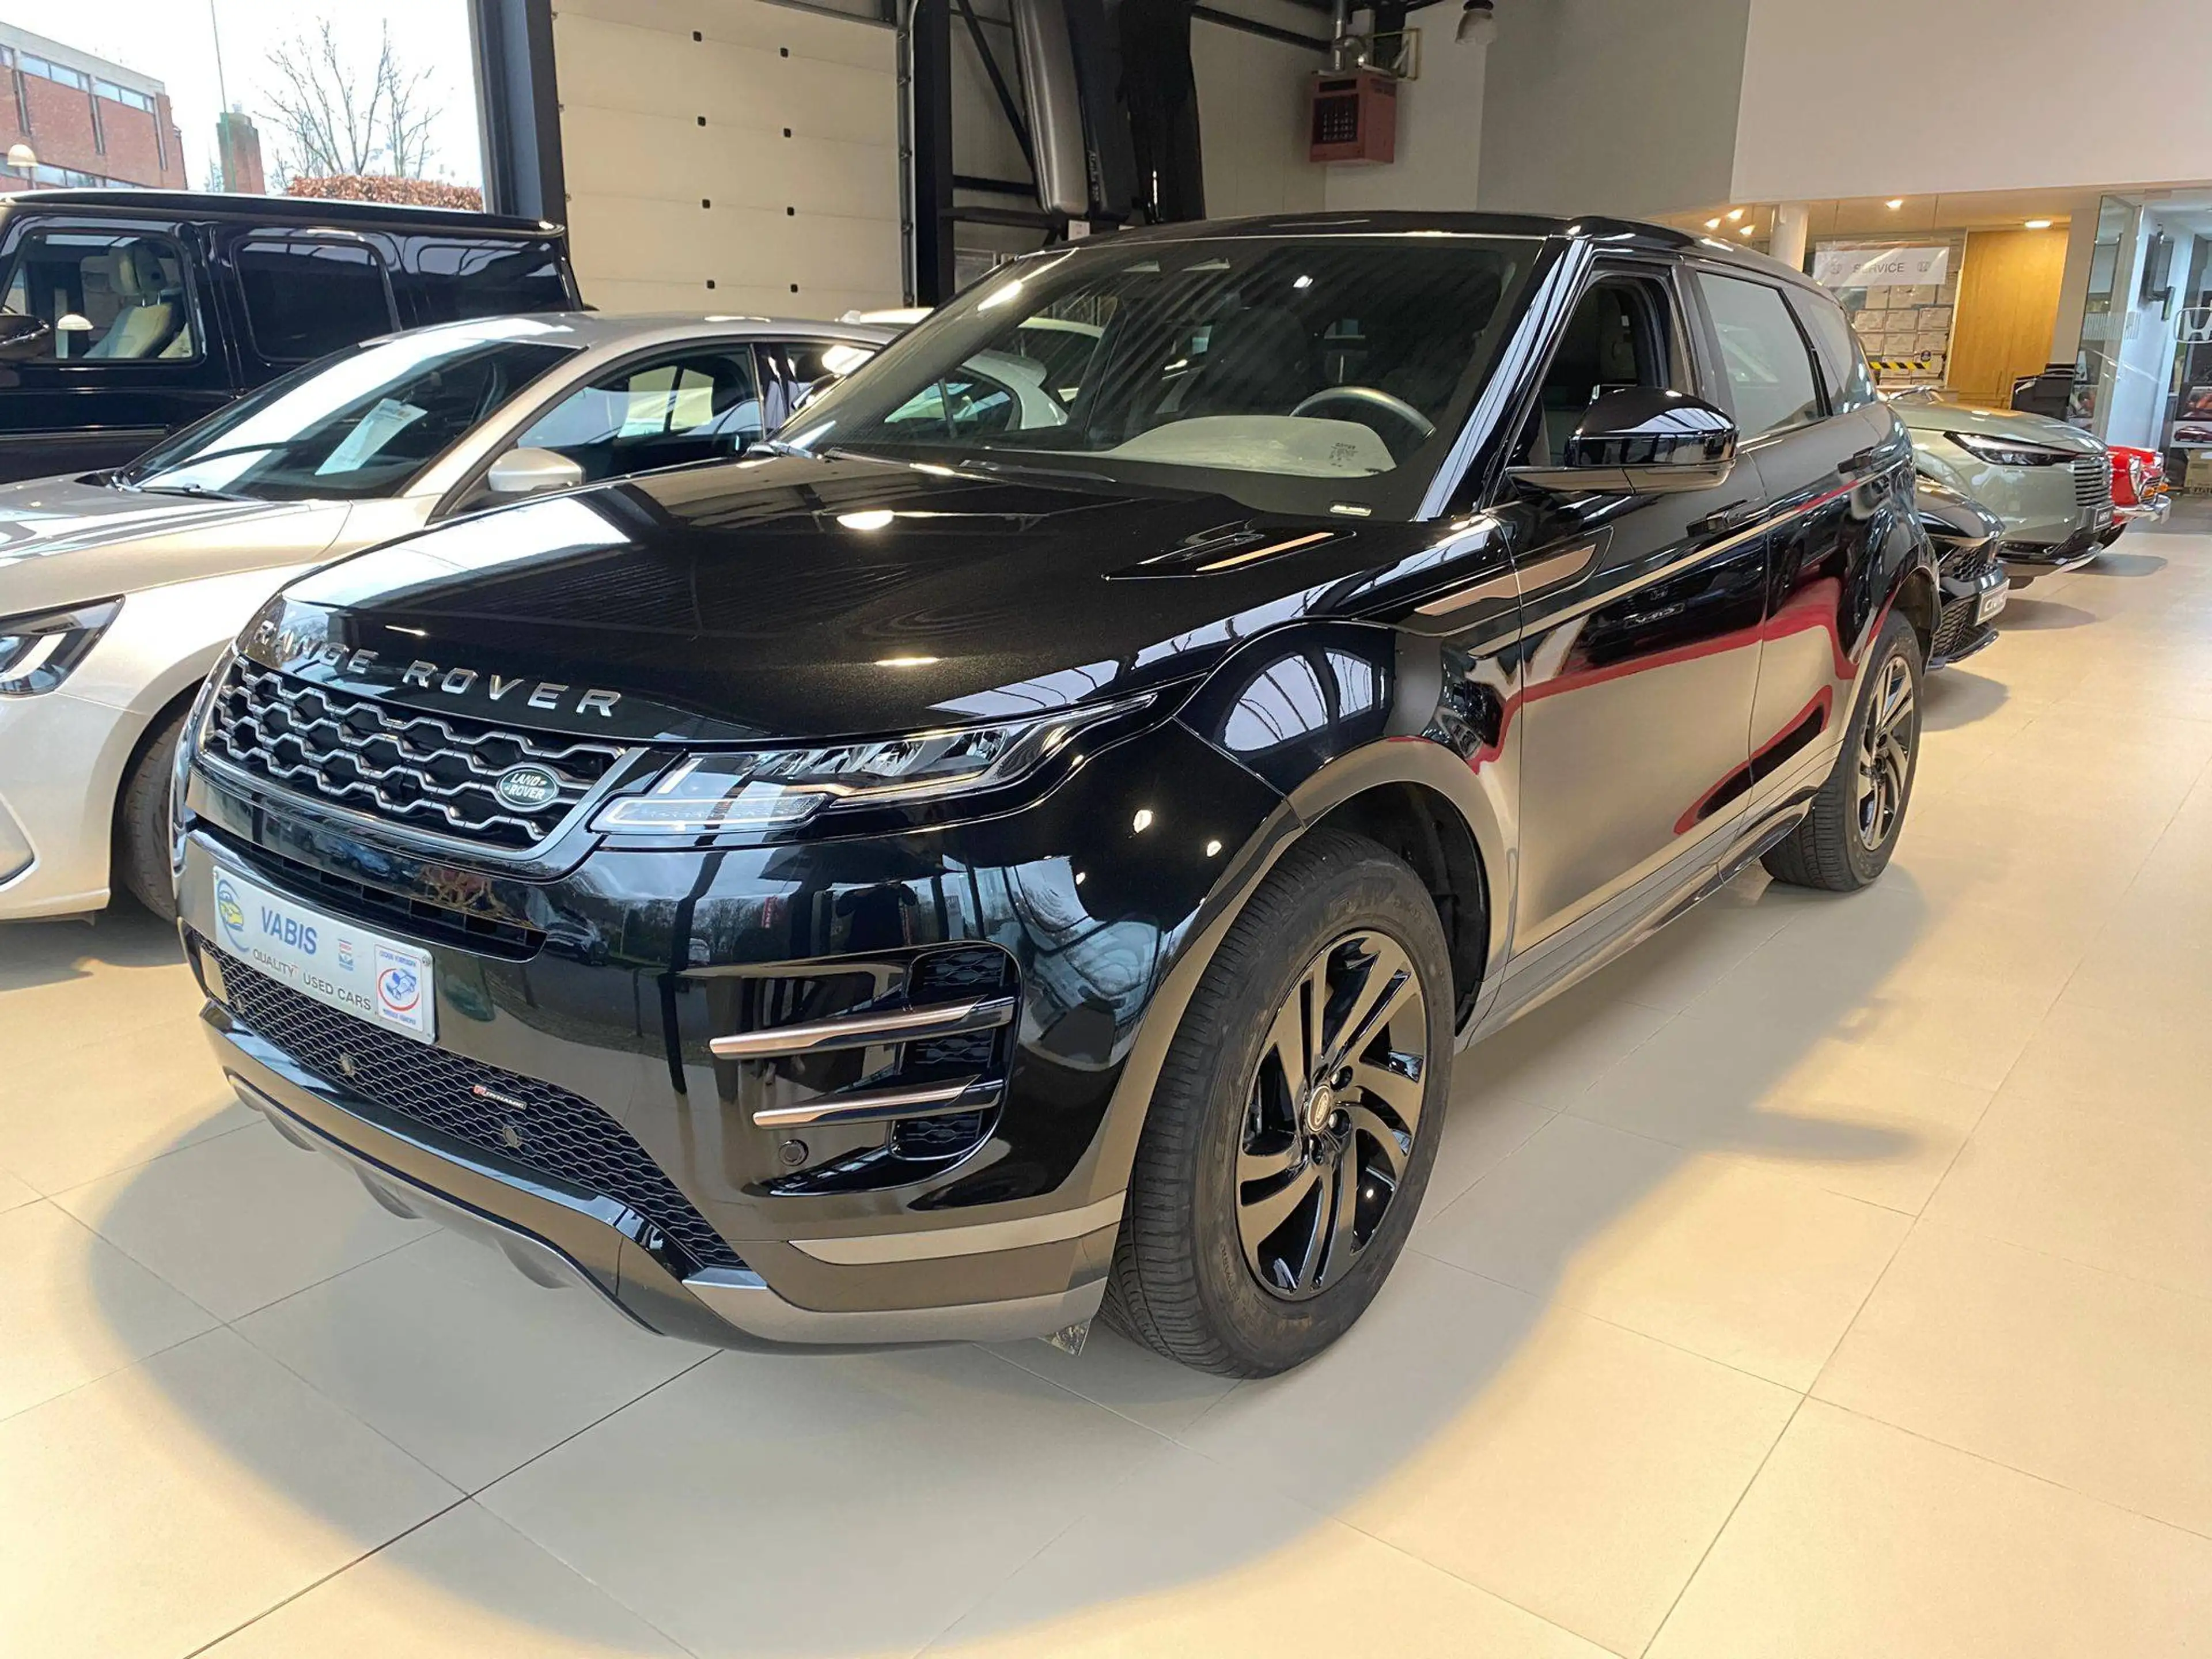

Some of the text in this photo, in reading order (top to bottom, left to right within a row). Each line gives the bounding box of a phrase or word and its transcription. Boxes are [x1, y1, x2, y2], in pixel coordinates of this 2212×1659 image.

[254, 620, 621, 717] RANGE ROVER
[508, 784, 546, 800] ROVER
[510, 773, 541, 786] LAND
[262, 906, 318, 955] VABIS
[253, 949, 371, 1010] QUALITY USED CARS
